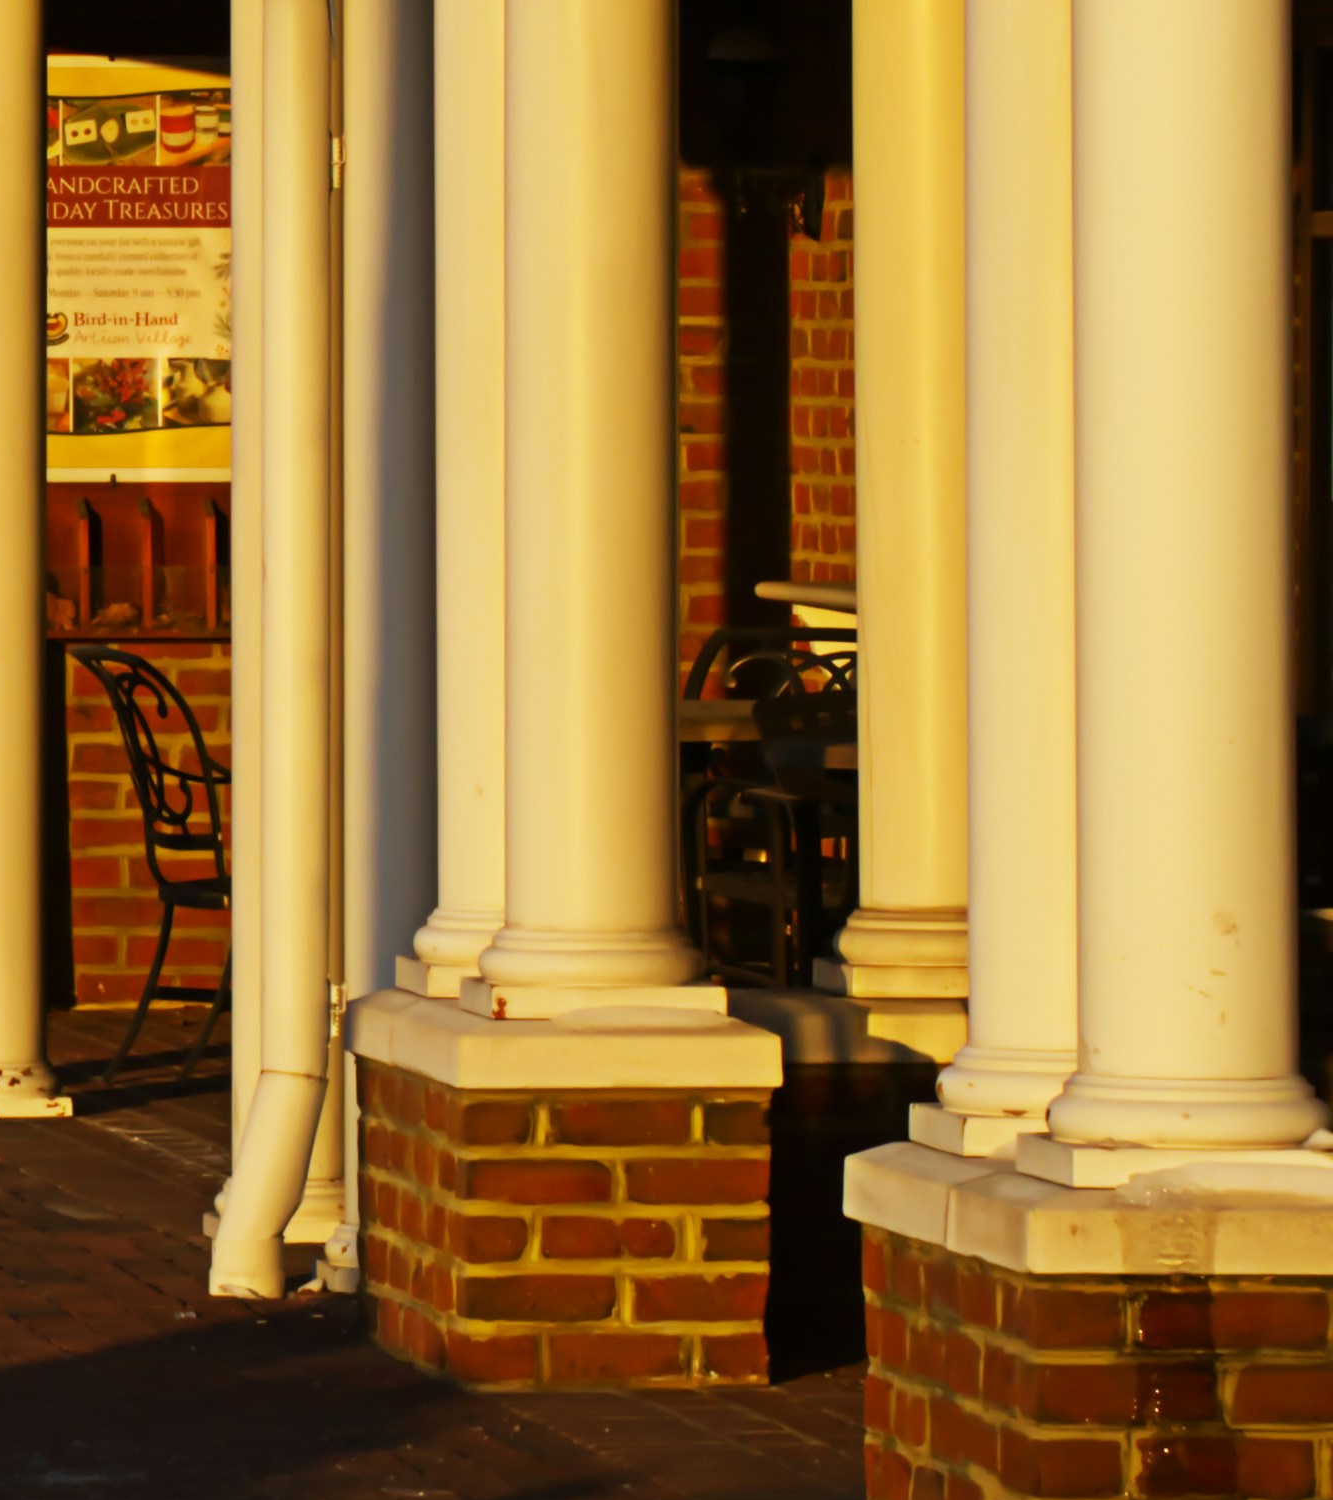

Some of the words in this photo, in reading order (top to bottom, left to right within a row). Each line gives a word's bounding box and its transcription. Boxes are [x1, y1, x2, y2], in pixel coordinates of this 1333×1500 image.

[47, 176, 200, 196] ANDCRAFTED
[103, 199, 229, 220] TREASURES
[73, 312, 179, 328] Bird-in-Hand
